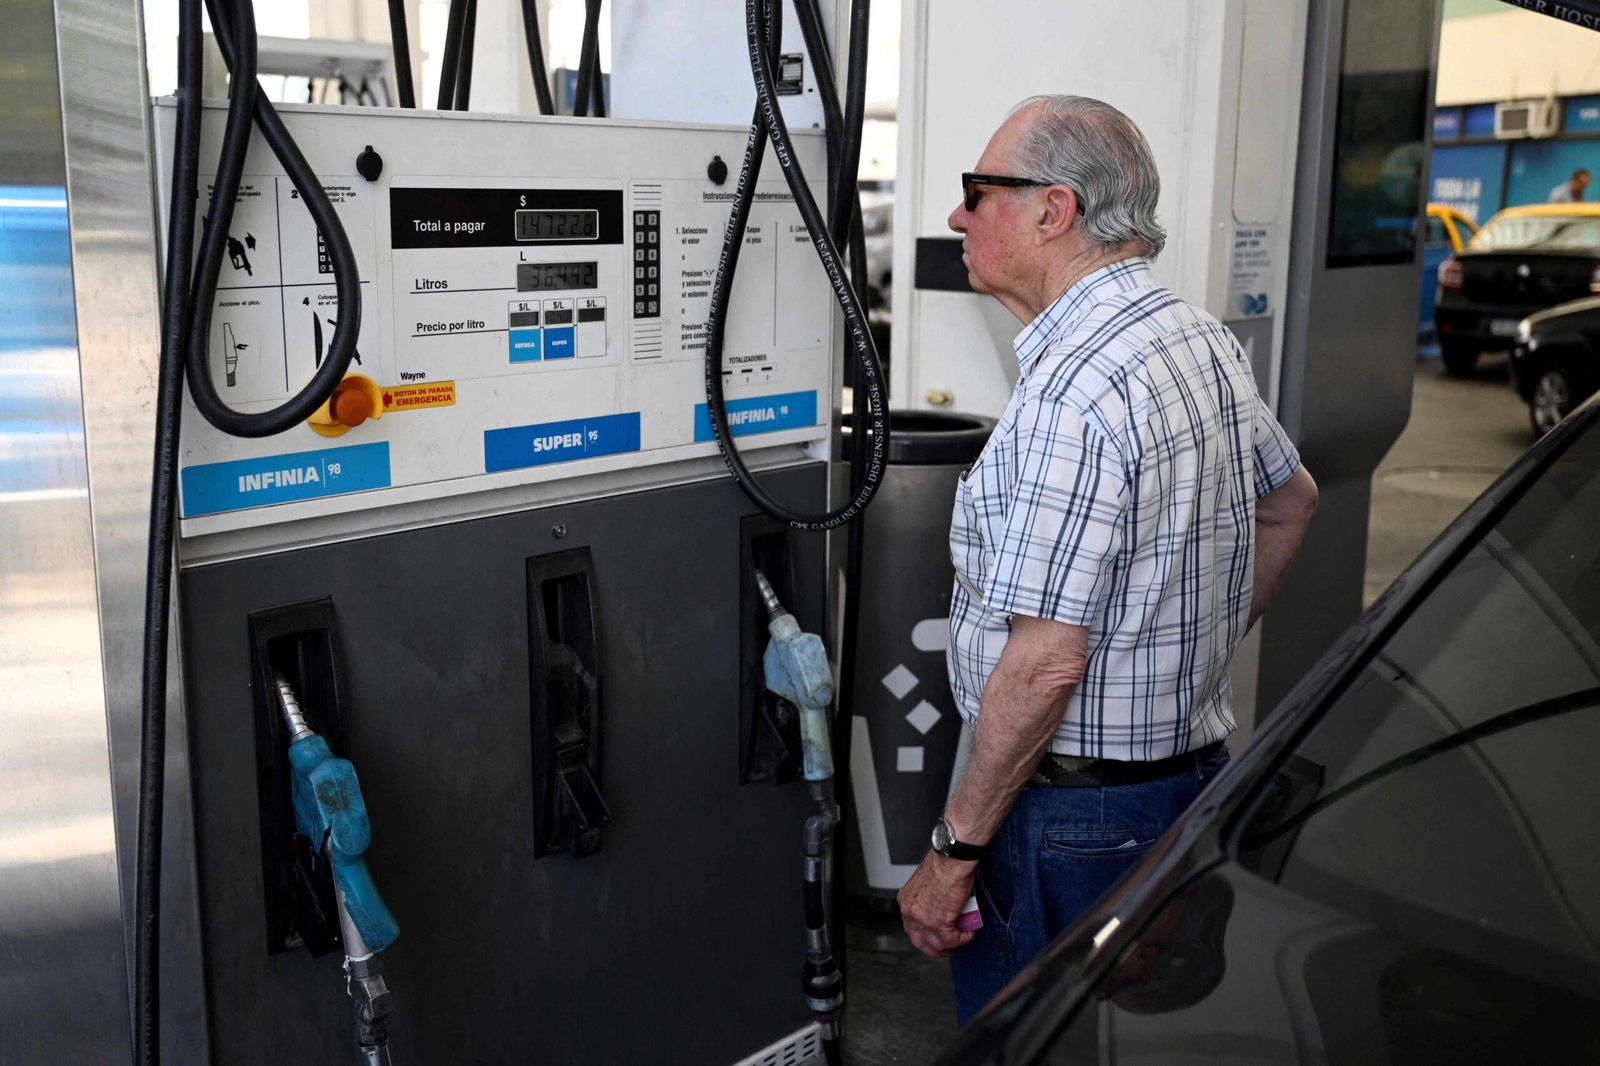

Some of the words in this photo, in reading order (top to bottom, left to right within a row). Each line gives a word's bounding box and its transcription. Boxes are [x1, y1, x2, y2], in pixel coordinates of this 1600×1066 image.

[750, 38, 762, 72] FUEL
[756, 75, 780, 140] GASOLINE
[747, 124, 757, 149] GPE
[777, 142, 790, 167] GPE
[729, 151, 751, 214] GASOLINE
[291, 189, 299, 199] 2
[520, 195, 526, 207] $
[413, 219, 441, 232] Total
[444, 223, 451, 231] a
[454, 221, 486, 234] pagar
[682, 226, 708, 234] Seleccione
[724, 217, 736, 244] FUEL
[520, 251, 527, 261] L
[531, 265, 593, 288] 36.442
[686, 279, 711, 287] seleccione
[710, 251, 728, 313] DISPENSER
[415, 279, 448, 290] Litros
[303, 296, 310, 306] 4
[688, 290, 708, 298] volumen
[519, 303, 530, 311] $/L
[553, 301, 564, 309] $/L
[586, 299, 597, 307] $/L
[416, 322, 447, 333] Precio
[449, 323, 465, 335] por
[467, 320, 485, 330] litro
[705, 317, 714, 348] HOSE
[551, 339, 568, 347] SUPER
[729, 354, 767, 364] TOTALIZADORES
[400, 371, 426, 382] Wayne
[394, 389, 416, 397] BOTON
[418, 388, 427, 396] DE
[428, 386, 453, 395] PARADA
[396, 393, 452, 407] EMERGENCIA
[870, 383, 882, 417] HOSE
[727, 407, 775, 426] INFINIA
[533, 432, 582, 453] SUPER
[588, 430, 598, 441] 95
[868, 419, 883, 482] DISPENSER
[238, 466, 320, 493] INFINIA
[327, 463, 341, 475] 98
[855, 484, 874, 508] FUEL
[811, 506, 857, 531] GASOLINE
